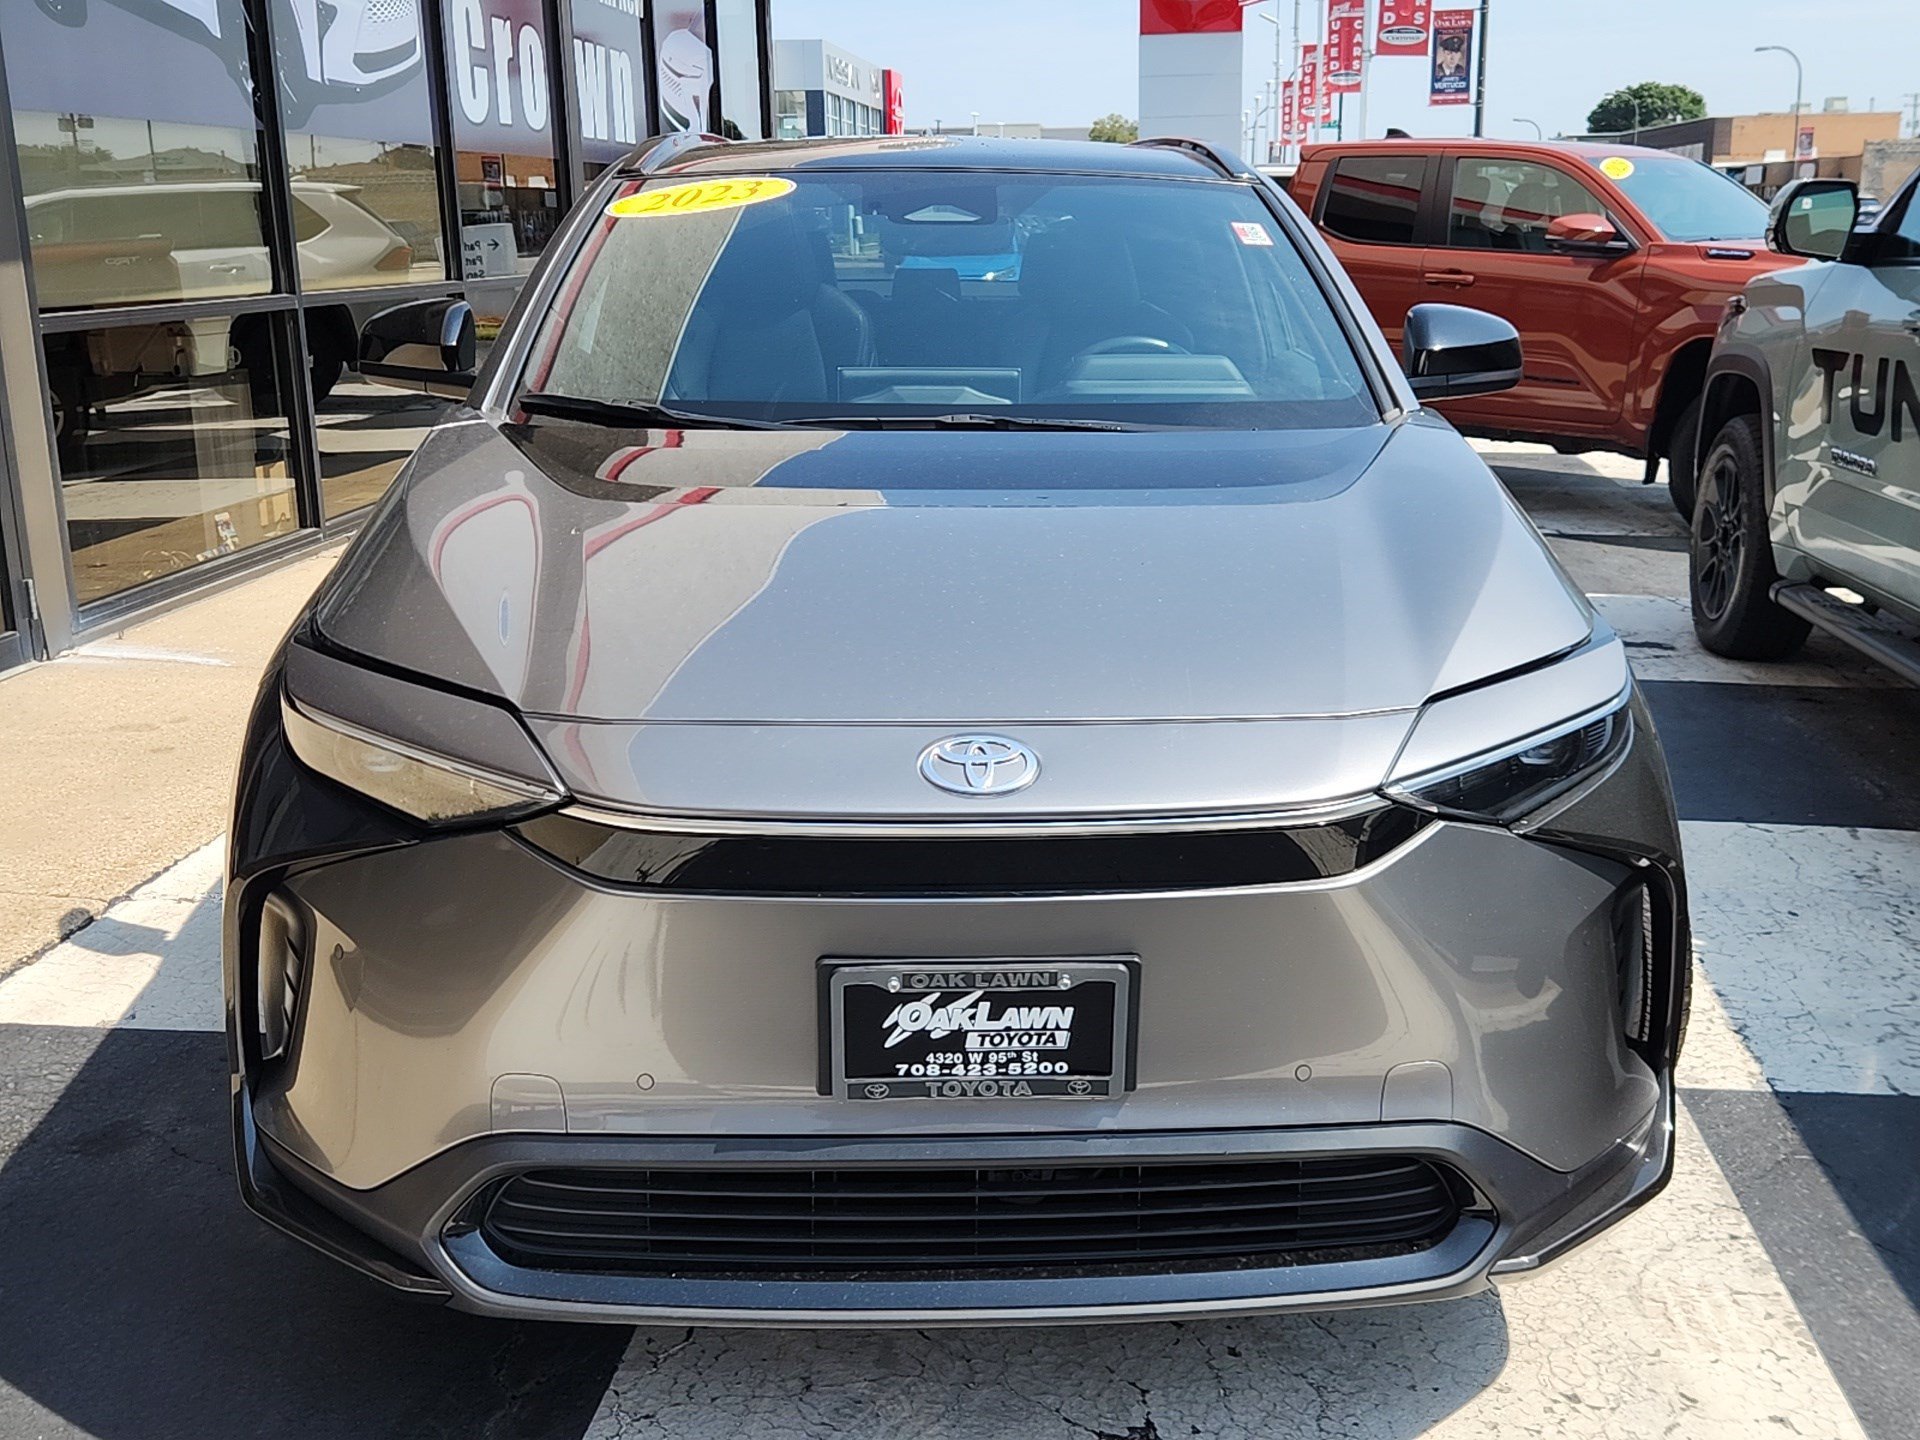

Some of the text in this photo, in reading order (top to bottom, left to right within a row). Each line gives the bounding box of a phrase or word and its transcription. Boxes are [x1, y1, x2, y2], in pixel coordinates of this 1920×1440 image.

[1329, 20, 1341, 71] USED
[1352, 20, 1363, 70] CARS
[637, 181, 764, 213] 2023
[910, 973, 1051, 988] OAK LAWN
[977, 1032, 1058, 1047] TOYOTA
[925, 1051, 1039, 1064] 4320 W 95th St
[895, 1062, 1069, 1077] 708-423-5200
[925, 1080, 1033, 1098] TOYOTA
